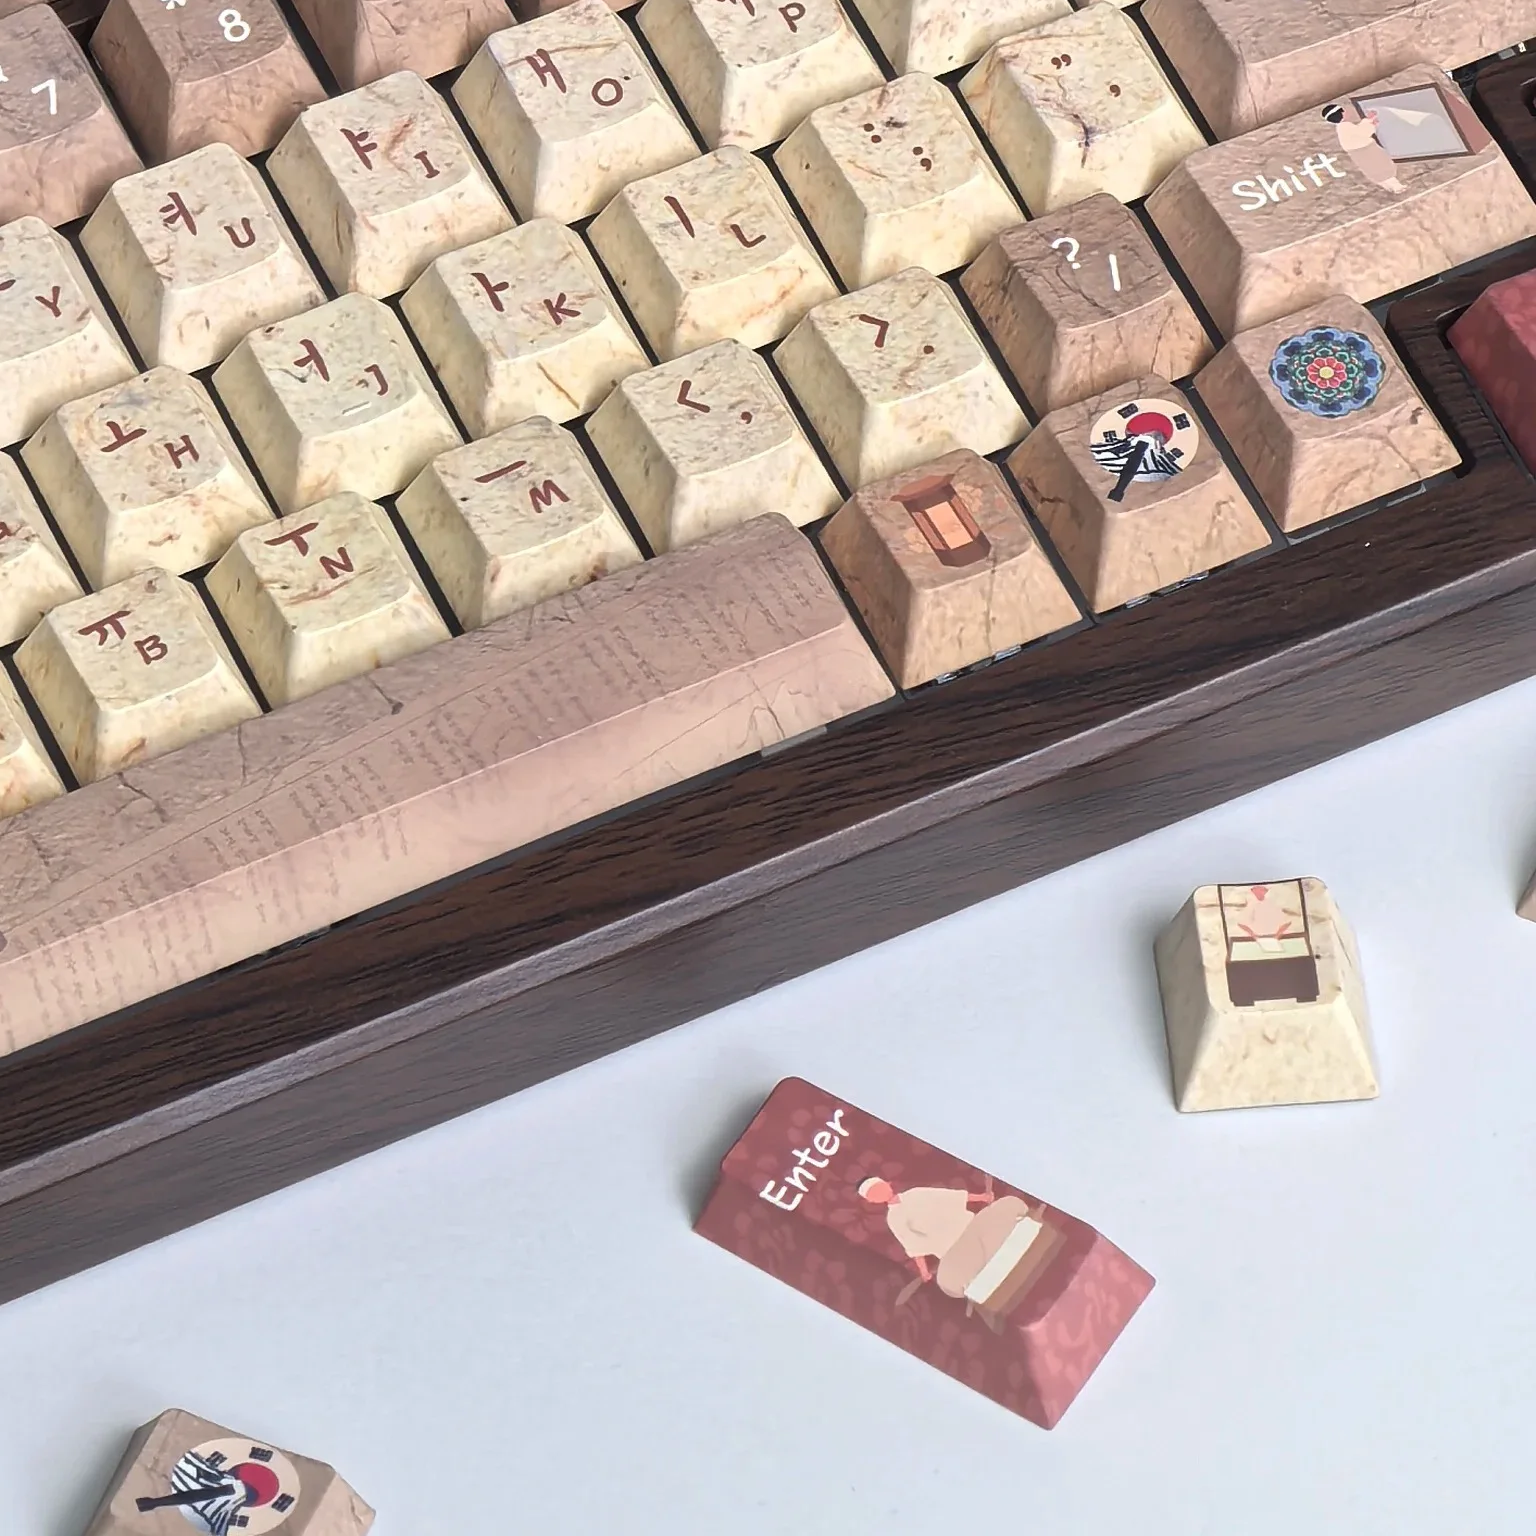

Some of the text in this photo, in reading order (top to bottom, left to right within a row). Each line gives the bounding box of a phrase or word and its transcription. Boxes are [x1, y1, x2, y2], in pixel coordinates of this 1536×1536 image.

[217, 8, 251, 42] 8
[778, 2, 806, 33] P
[30, 78, 57, 115] 7
[1232, 153, 1346, 211] Shift
[223, 217, 256, 249] U
[729, 223, 767, 249] L
[1050, 236, 1081, 270] ?
[34, 285, 62, 318] Y
[543, 292, 581, 326] K
[856, 313, 890, 349] >
[364, 363, 389, 396] J
[676, 379, 711, 414] <
[163, 434, 200, 470] H
[528, 479, 571, 514] M
[319, 546, 354, 580] N
[133, 634, 168, 665] B
[759, 1109, 850, 1211] Enter
